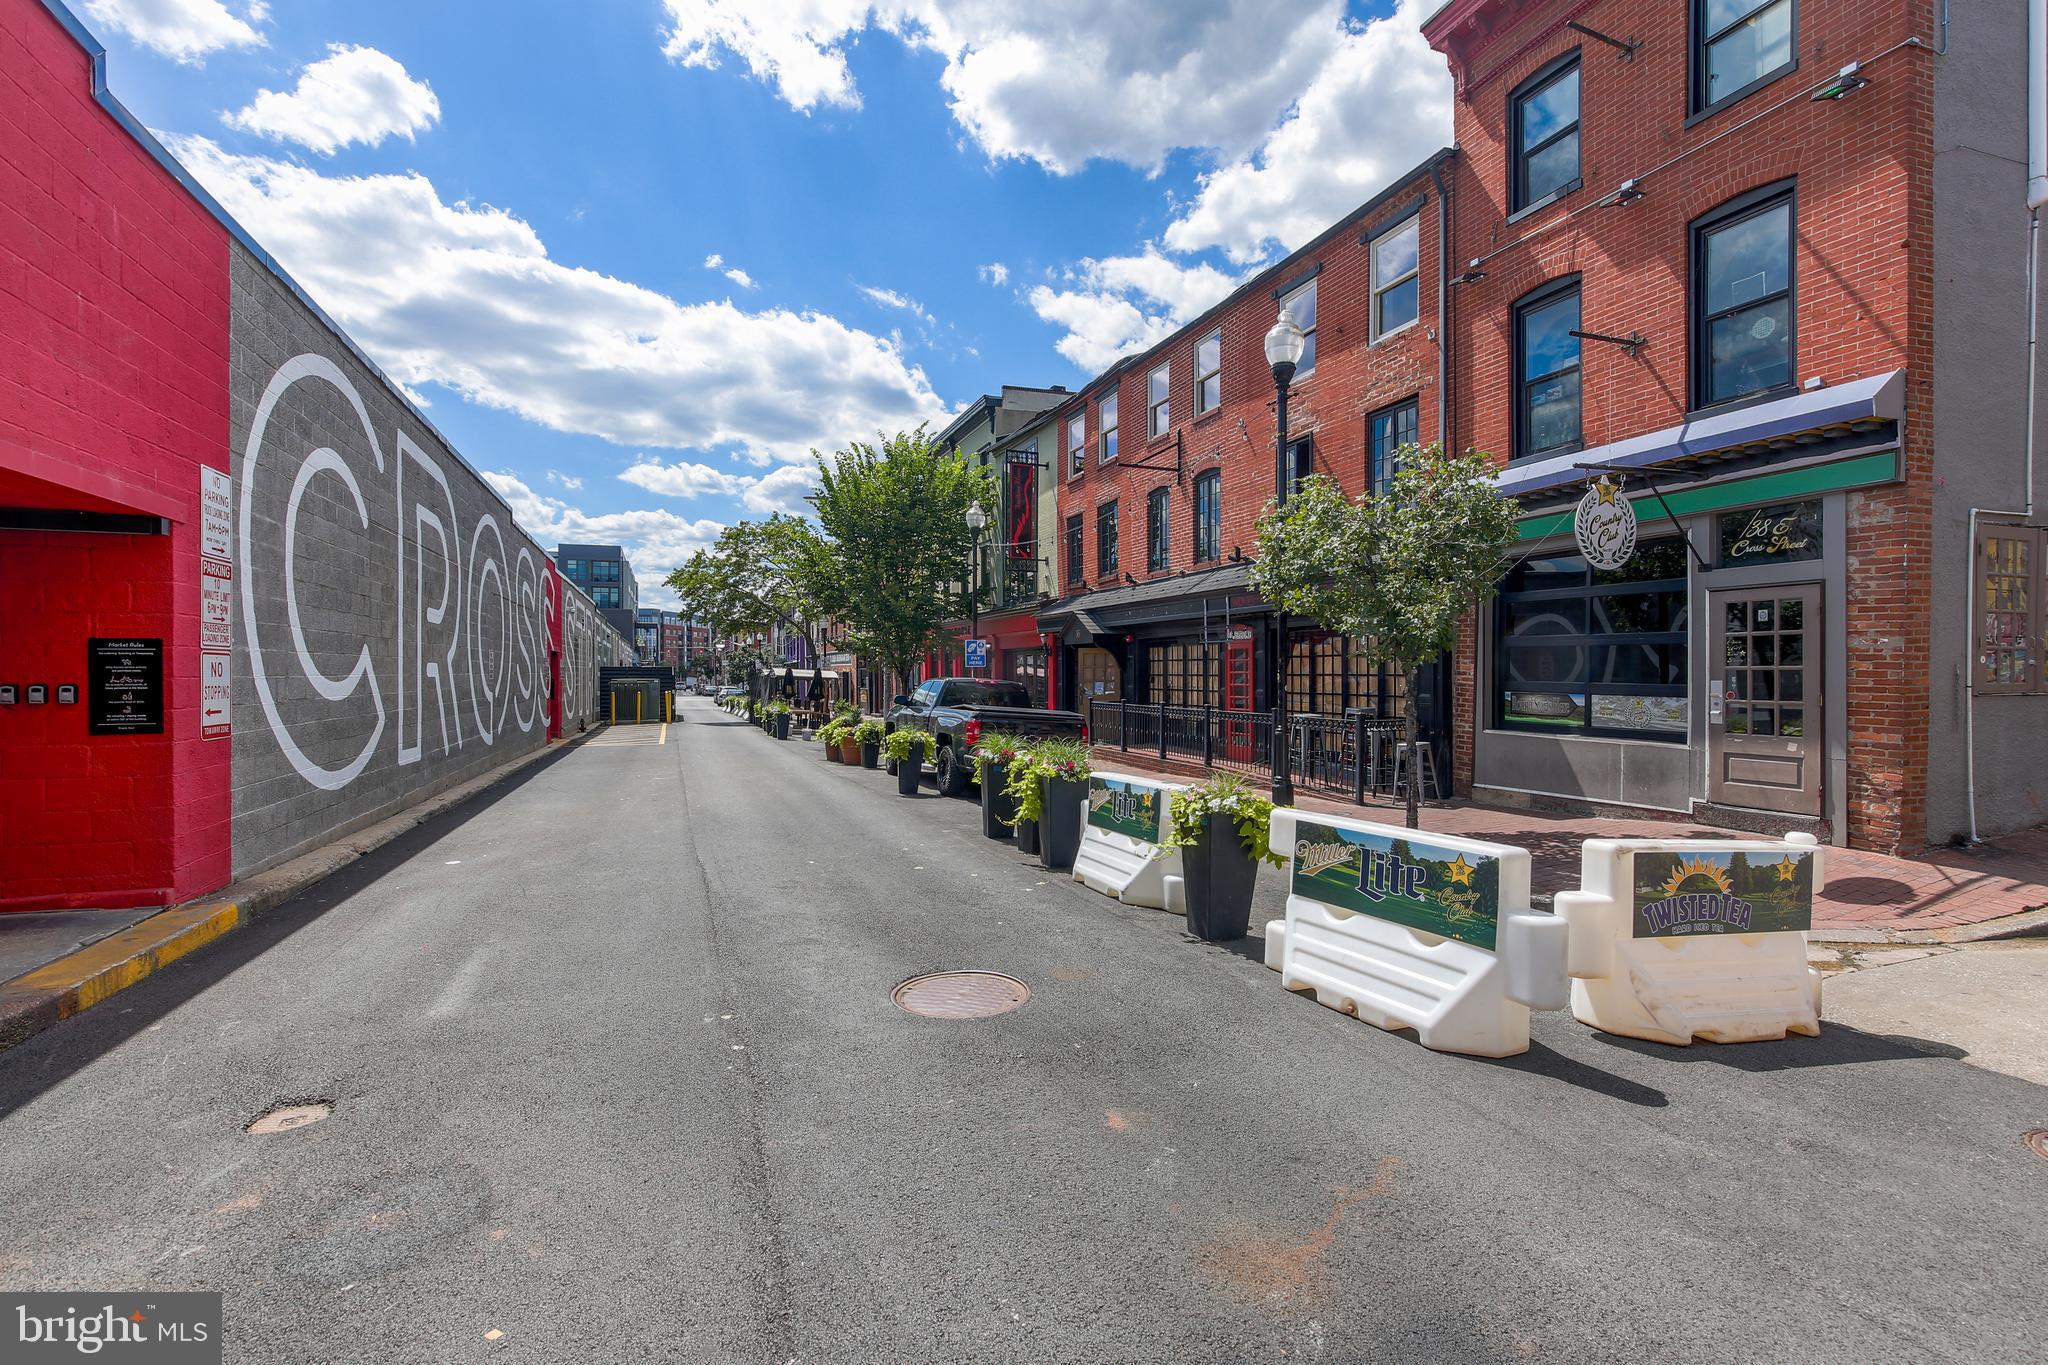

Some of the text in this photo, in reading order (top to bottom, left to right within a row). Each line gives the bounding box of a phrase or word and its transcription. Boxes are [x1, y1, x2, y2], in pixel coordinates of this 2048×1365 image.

[212, 475, 221, 489] NO
[204, 489, 229, 508] PARKING
[1589, 512, 1623, 536] Country
[1737, 508, 1773, 538] 138
[1597, 527, 1620, 548] Club
[1731, 536, 1808, 557] Cross Street
[203, 561, 231, 578] PARKING
[240, 353, 556, 790] CROSS
[214, 578, 220, 590] 10
[204, 589, 219, 601] MINUTE
[203, 632, 230, 644] LOADING ZONE
[204, 623, 229, 635] PASSENGER
[211, 661, 223, 678] NO
[204, 685, 230, 700] STOPPING
[1111, 790, 1136, 823] Lite
[1296, 839, 1426, 902] Miller Lite
[1436, 887, 1481, 906] Country
[1447, 903, 1474, 921] Club
[1642, 893, 1753, 934] TWISTED TEA
[1671, 923, 1724, 935] HARD ICED TEA
